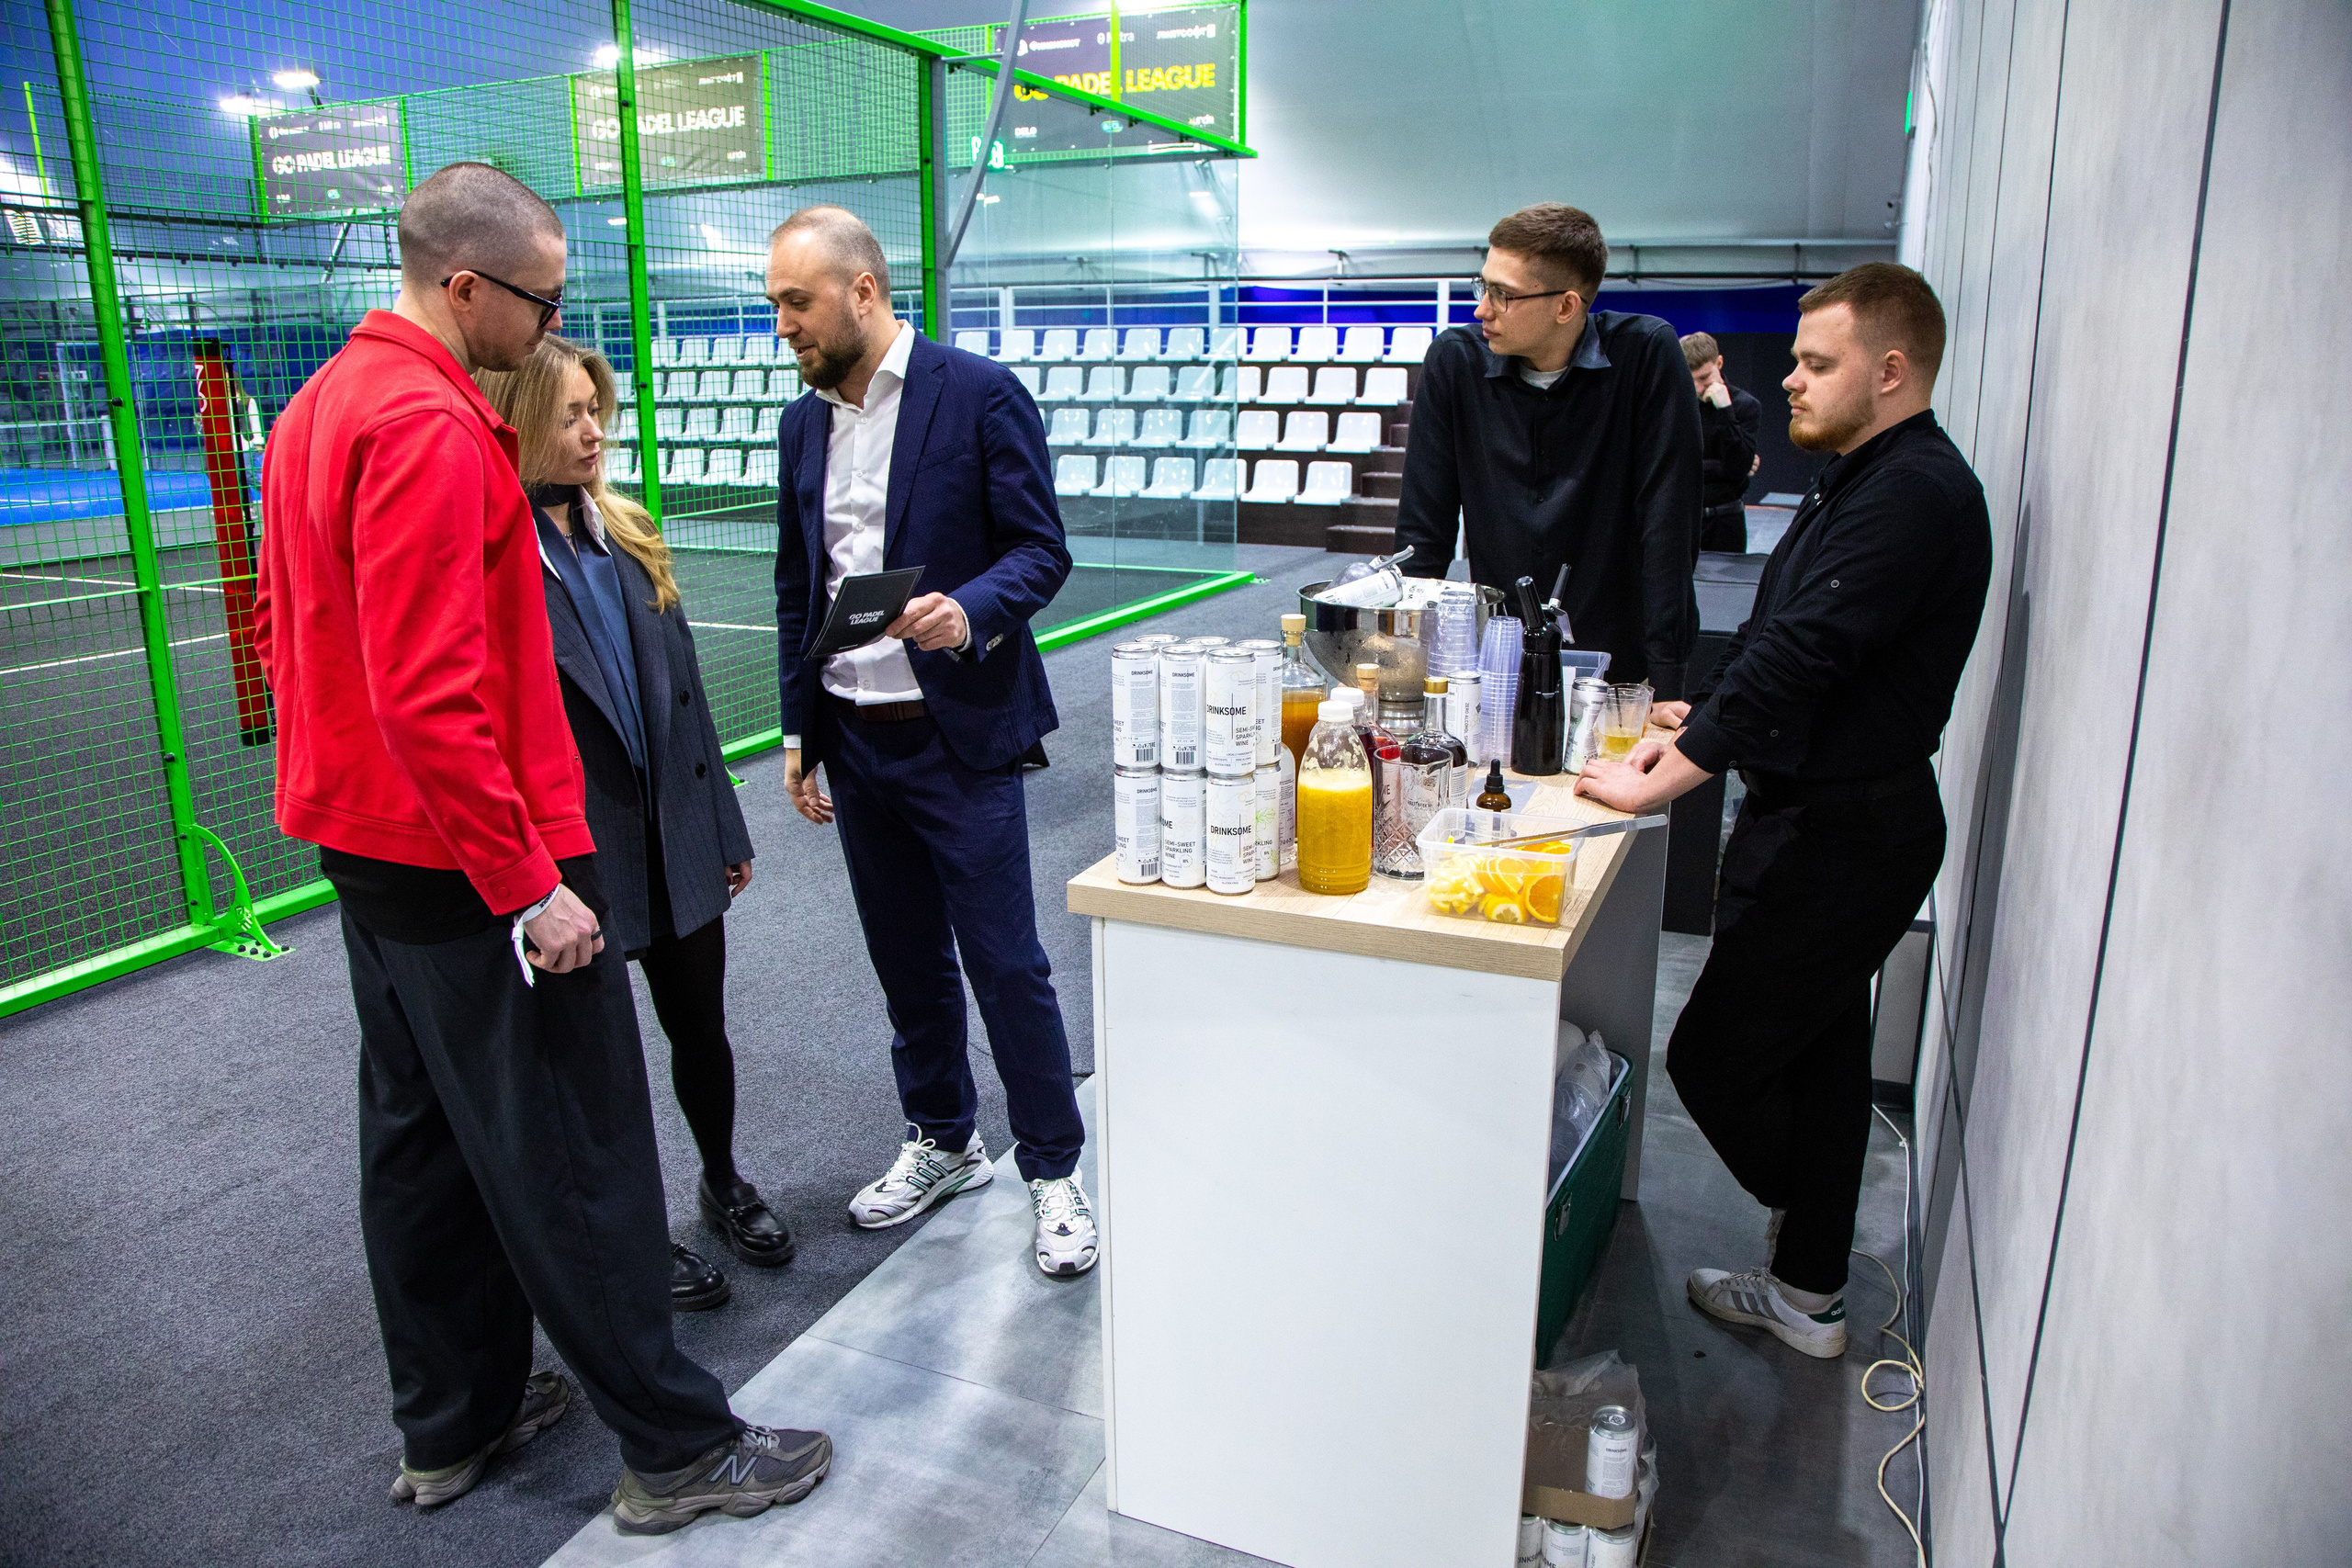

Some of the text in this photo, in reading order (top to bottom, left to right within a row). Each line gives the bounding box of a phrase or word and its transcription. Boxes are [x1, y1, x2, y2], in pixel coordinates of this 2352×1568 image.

[1125, 63, 1216, 93] LEAGUE
[592, 106, 745, 141] GO ADEL LEAGUE
[272, 146, 391, 175] GO PADEL LEAGUE
[863, 610, 885, 619] PADEL
[850, 616, 878, 625] LEAGUE
[1210, 825, 1251, 836] DRINKSOME
[1165, 840, 1195, 848] SEMI-SWEET
